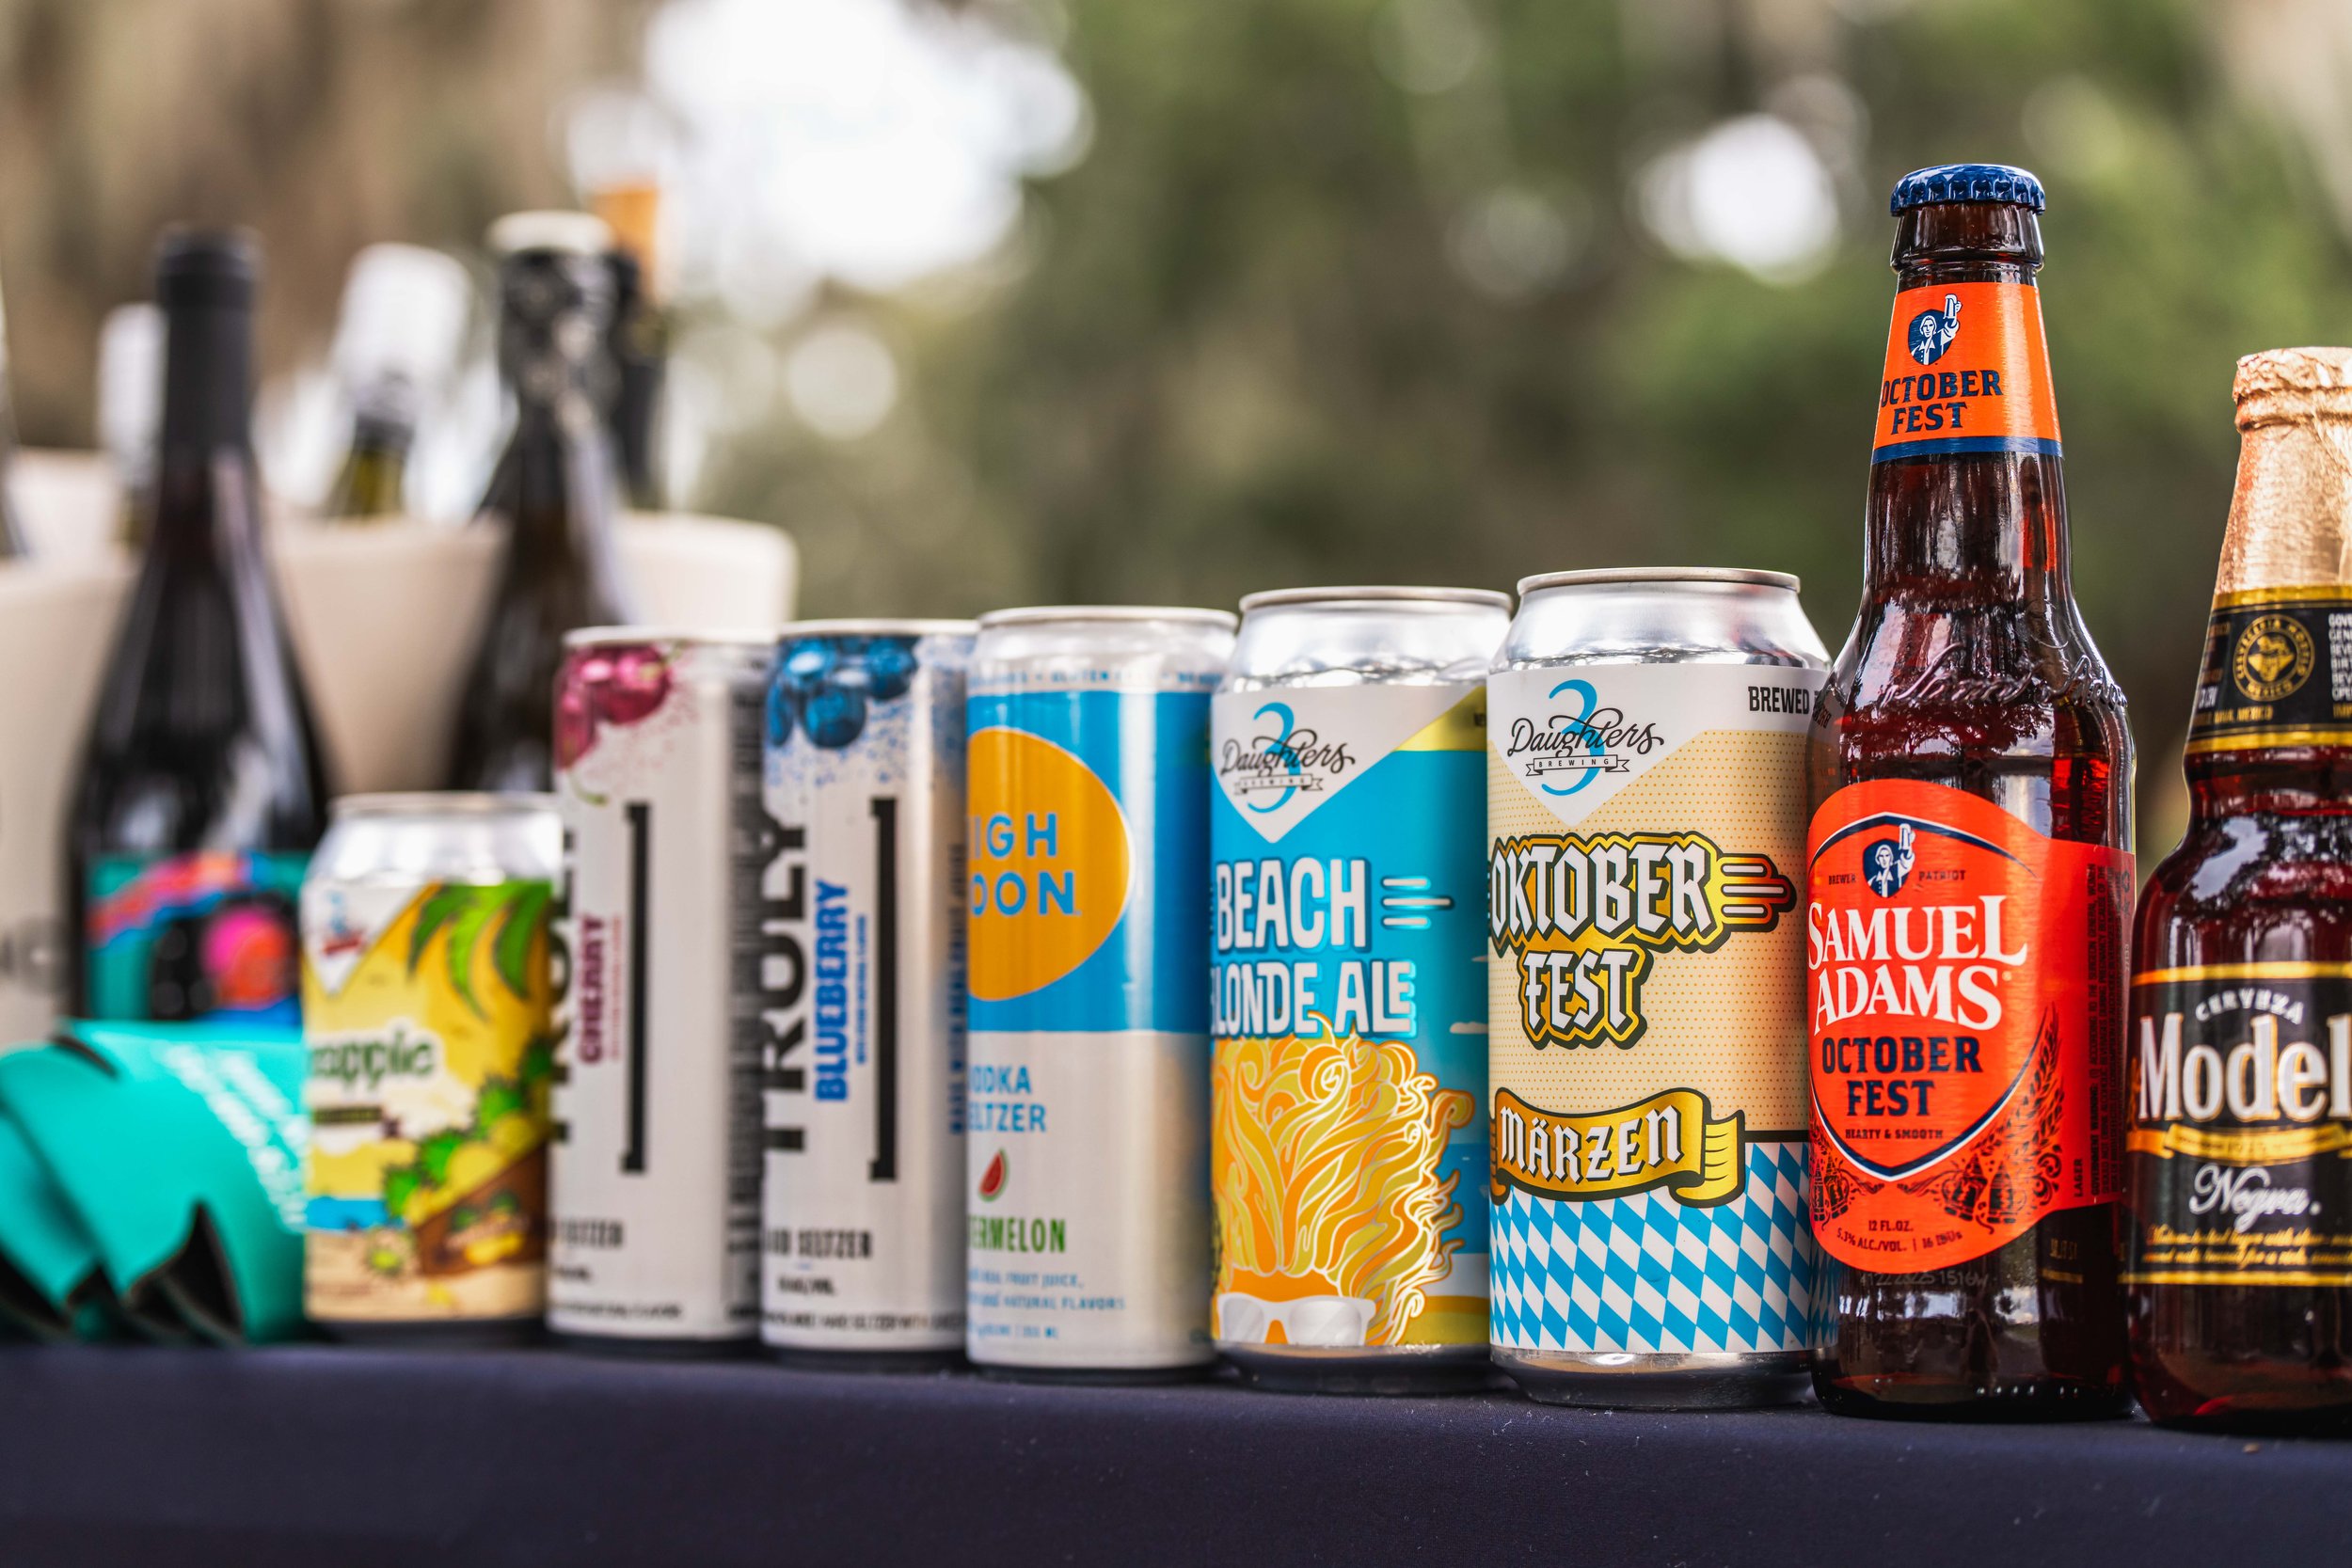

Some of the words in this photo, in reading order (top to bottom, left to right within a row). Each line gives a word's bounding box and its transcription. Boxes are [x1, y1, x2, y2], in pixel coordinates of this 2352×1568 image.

[1882, 369, 2003, 407] OCTOBER
[1891, 402, 1967, 435] FEST
[1748, 686, 1810, 715] BREWED
[1507, 707, 1664, 757] Daughters
[1541, 679, 1605, 797] 3
[1220, 728, 1356, 778] Daughters
[1538, 758, 1610, 768] BREWING
[971, 812, 1057, 859] IGH
[969, 871, 1074, 917] OON
[1491, 843, 1712, 942] OKTOBER
[1828, 873, 1856, 886] BREWER
[1918, 869, 1966, 881] PATRIOT
[1216, 857, 1367, 951] BEACH
[1808, 895, 2027, 971] SAMUEL
[816, 879, 848, 1101] BLUEBERRY
[1211, 961, 1318, 1036] LONDE
[1333, 960, 1412, 1034] ALE
[1522, 947, 1634, 1033] FEST
[1814, 964, 2002, 1037] ADAMS
[2195, 988, 2304, 1025] CERVEZA
[1821, 1036, 1983, 1074] OCTOBER
[969, 1064, 1032, 1095] ODKA
[1846, 1080, 1935, 1117] FEST
[968, 1102, 1047, 1133] ELTZER
[1845, 1129, 1882, 1139] HEARTY
[1884, 1129, 1892, 1139] &
[1895, 1129, 1944, 1140] SMOOTH
[2074, 1159, 2083, 1197] LAGER
[1836, 1227, 1856, 1246] 5.3%
[1867, 1220, 1878, 1231] 12
